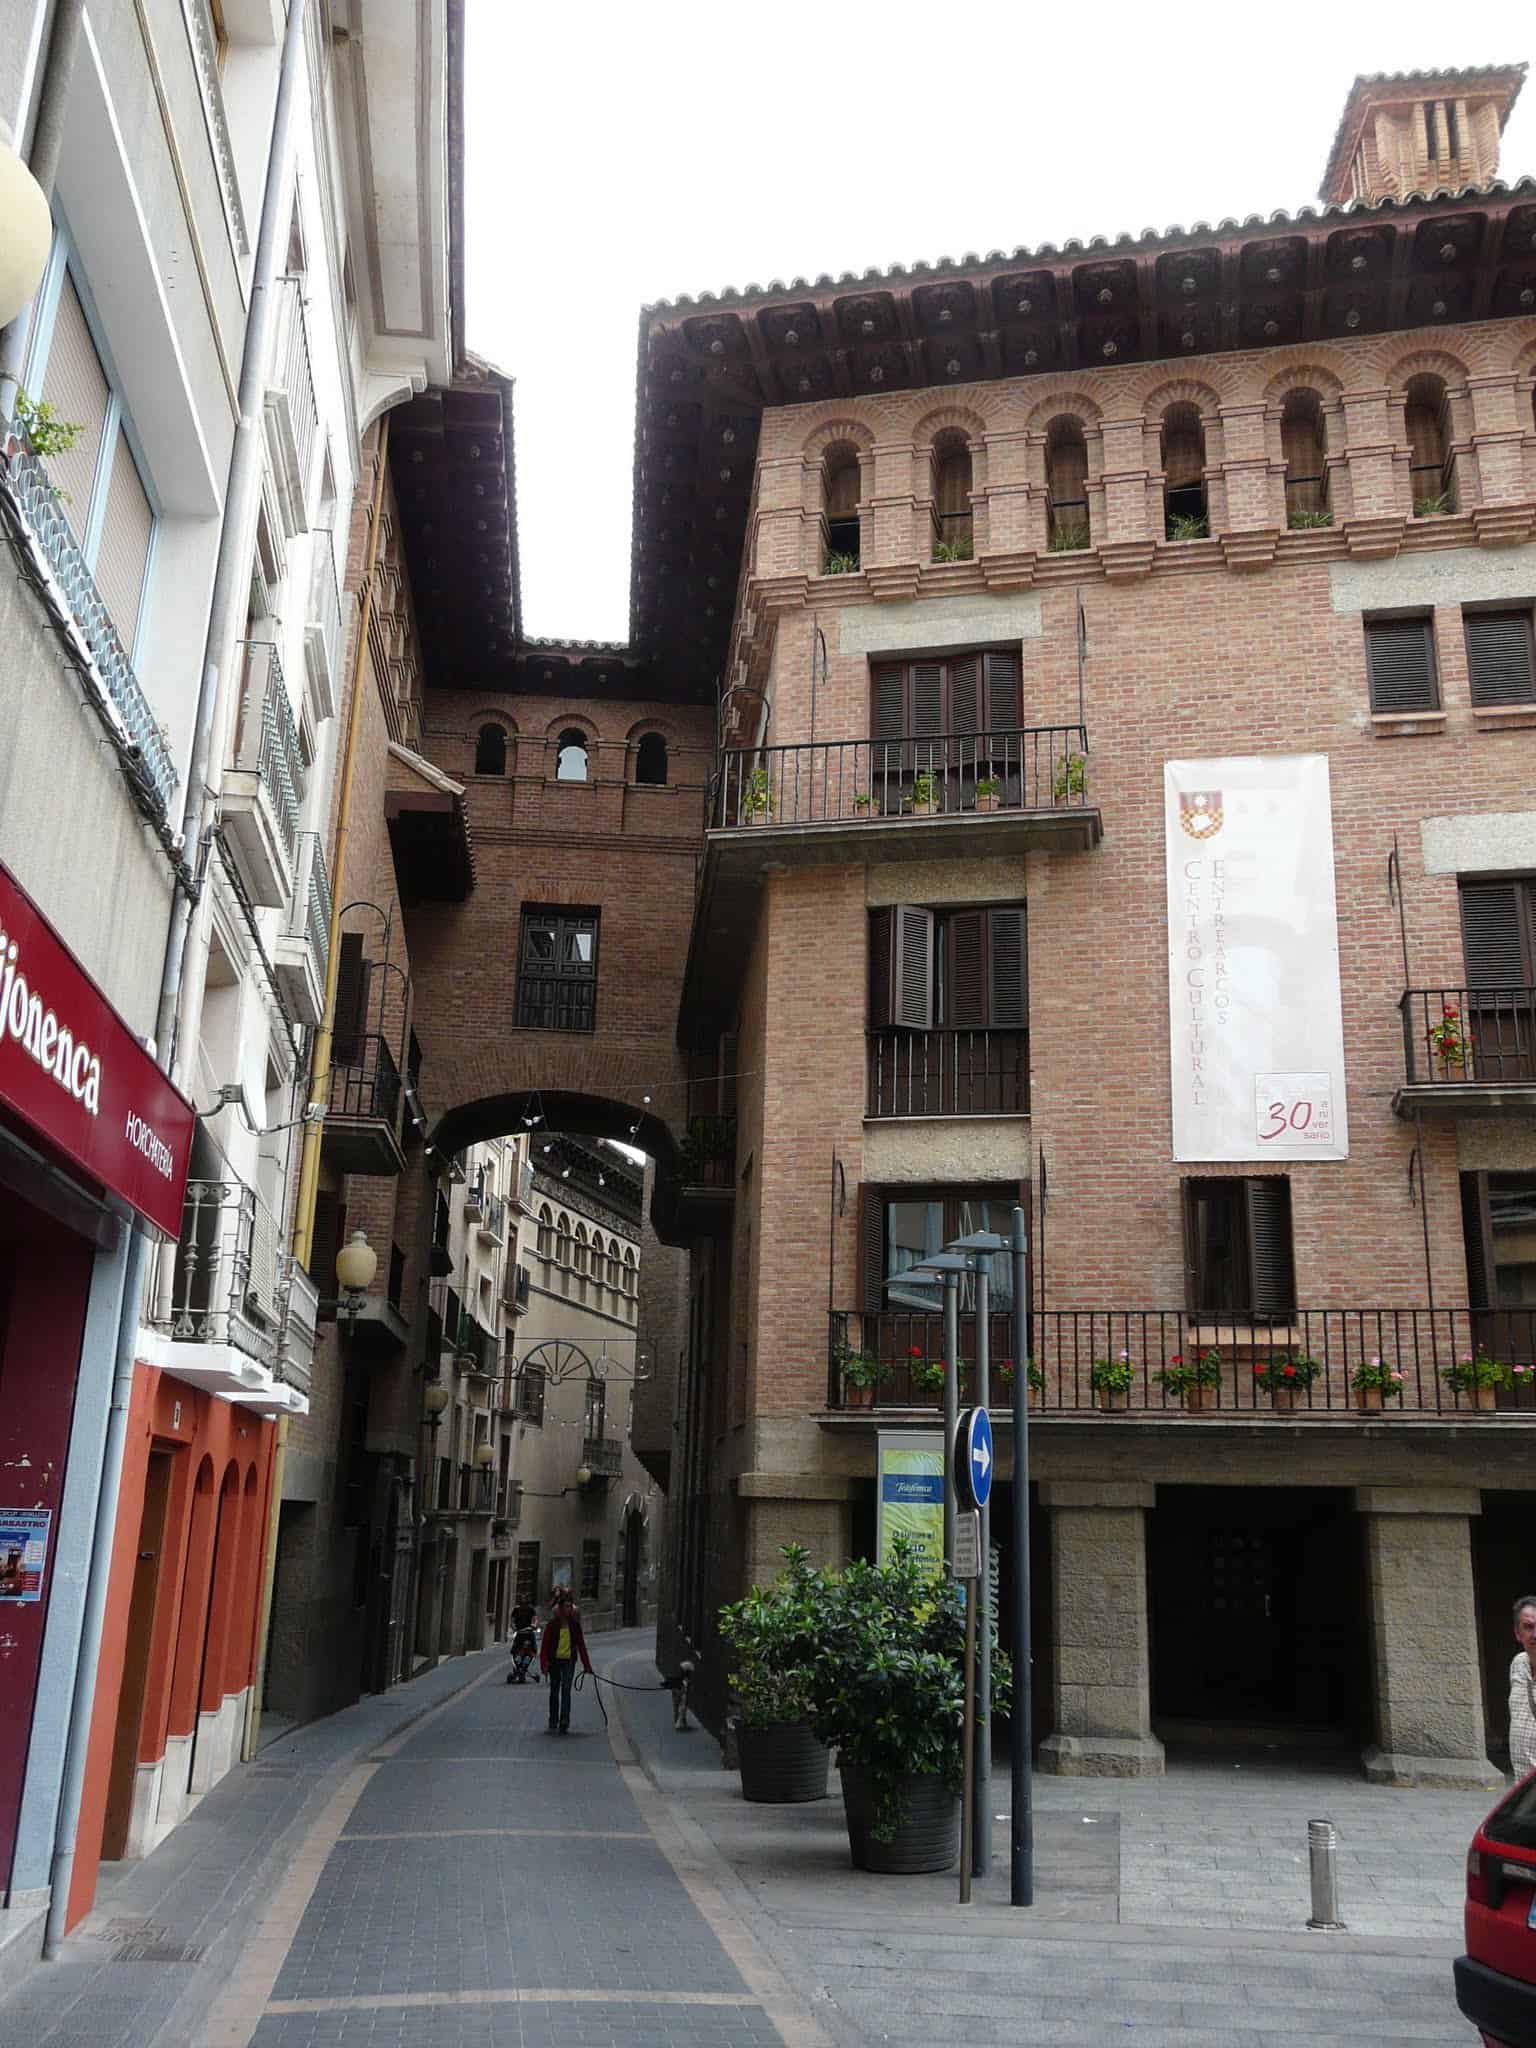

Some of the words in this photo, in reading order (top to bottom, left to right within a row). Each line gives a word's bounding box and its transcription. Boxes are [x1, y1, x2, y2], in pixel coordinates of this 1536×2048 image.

[1184, 860, 1203, 961] CENTRO
[1211, 859, 1229, 1025] ENTREARCOS
[1186, 968, 1207, 1106] CULTURAL
[1258, 1101, 1312, 1139] 30
